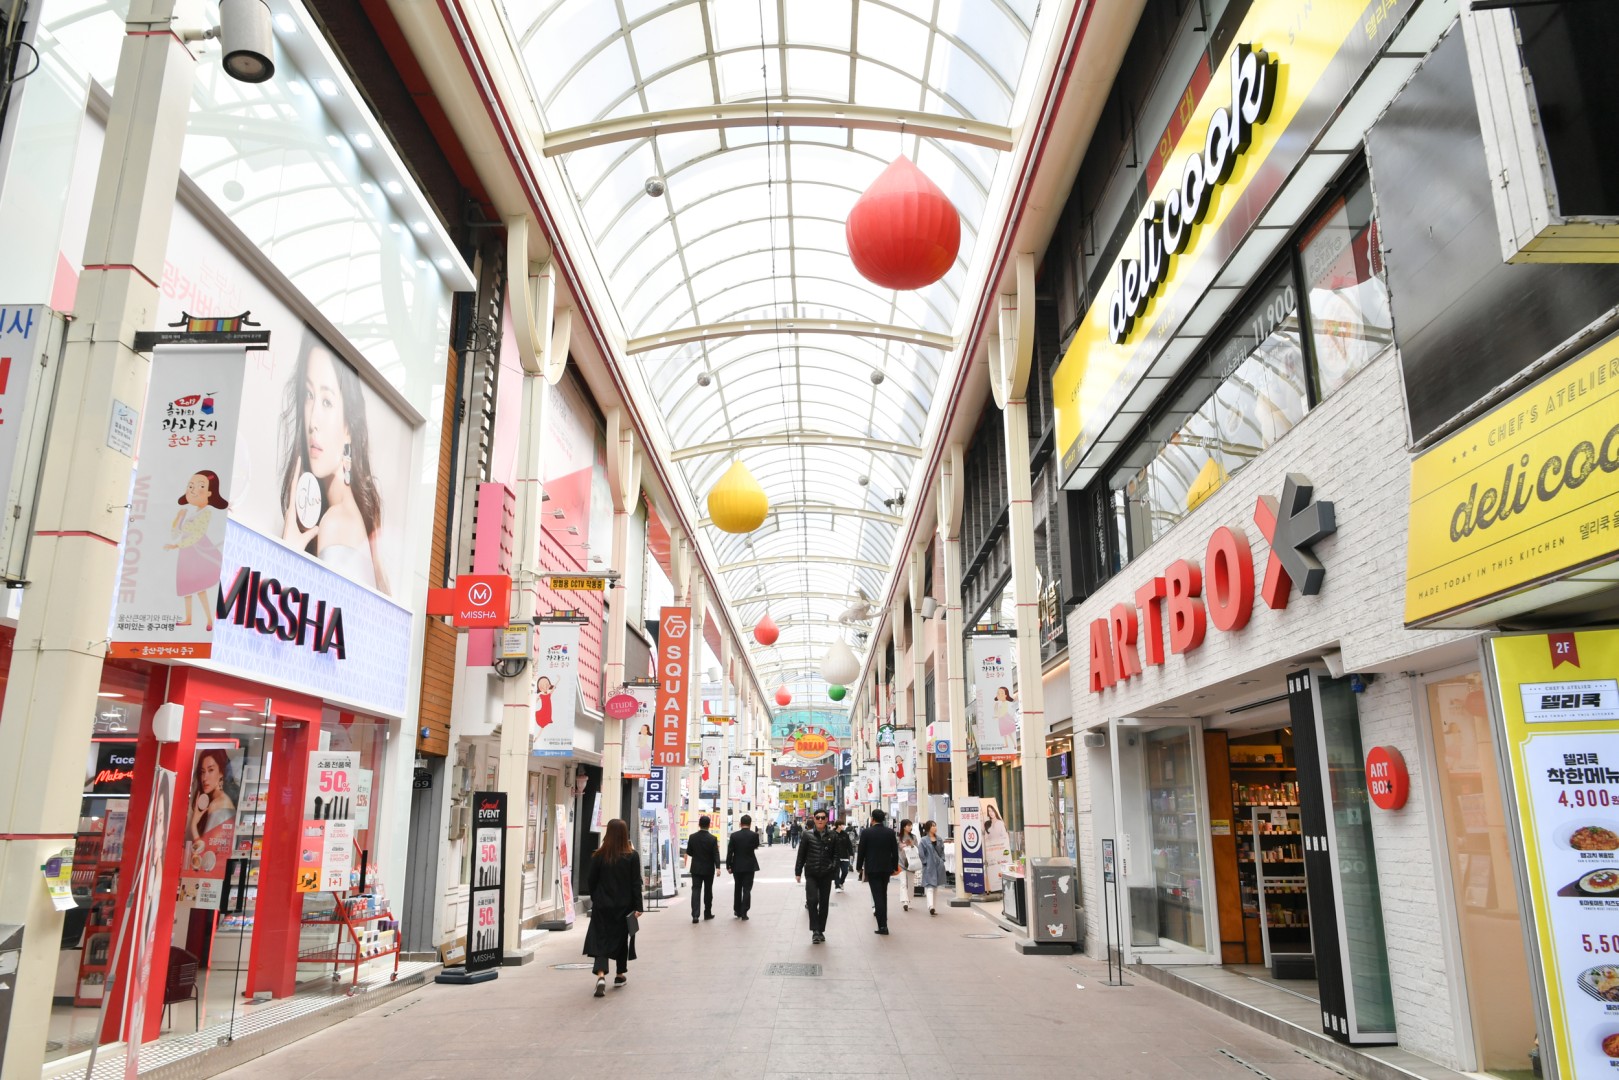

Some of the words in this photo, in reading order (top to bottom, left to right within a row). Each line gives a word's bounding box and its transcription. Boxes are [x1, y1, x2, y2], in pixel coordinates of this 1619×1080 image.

[1108, 42, 1279, 345] delicook
[1488, 404, 1539, 447] CHEF'S
[1545, 357, 1619, 416] ATELIER
[162, 417, 218, 433] 관광도시
[168, 433, 191, 448] 울산
[195, 433, 217, 448] 중구
[117, 475, 152, 604] WELCOME
[1418, 585, 1439, 600] MADE
[1443, 572, 1472, 591] TODAY
[1477, 567, 1487, 577] IN
[1492, 556, 1514, 572] THIS
[1519, 536, 1566, 561] KITCHEN
[570, 579, 585, 588] CCTV
[1089, 473, 1337, 693] ARTBOX
[216, 566, 346, 660] MISSHA
[460, 611, 497, 619] MISSHA
[117, 622, 145, 631] 재미있는
[146, 622, 175, 632] 중구여행
[142, 645, 179, 656] 울산광역시
[181, 646, 194, 656] 중구
[1555, 641, 1570, 655] 2F
[663, 645, 683, 746] SQUARE
[1541, 693, 1601, 710] 델리쿡
[610, 702, 634, 710] ETUDE
[797, 741, 825, 751] DREAM
[110, 754, 135, 765] Face
[659, 751, 681, 763] 101
[1563, 753, 1599, 766] 델리쿡
[317, 761, 331, 769] 소품
[331, 761, 352, 769] 전품목
[1370, 762, 1388, 778] ART
[319, 770, 351, 793] 50%
[1547, 767, 1619, 785] 착한메뉴
[1372, 780, 1393, 795] BOX
[478, 809, 500, 819] EVENT
[473, 952, 496, 964] MISSHA
